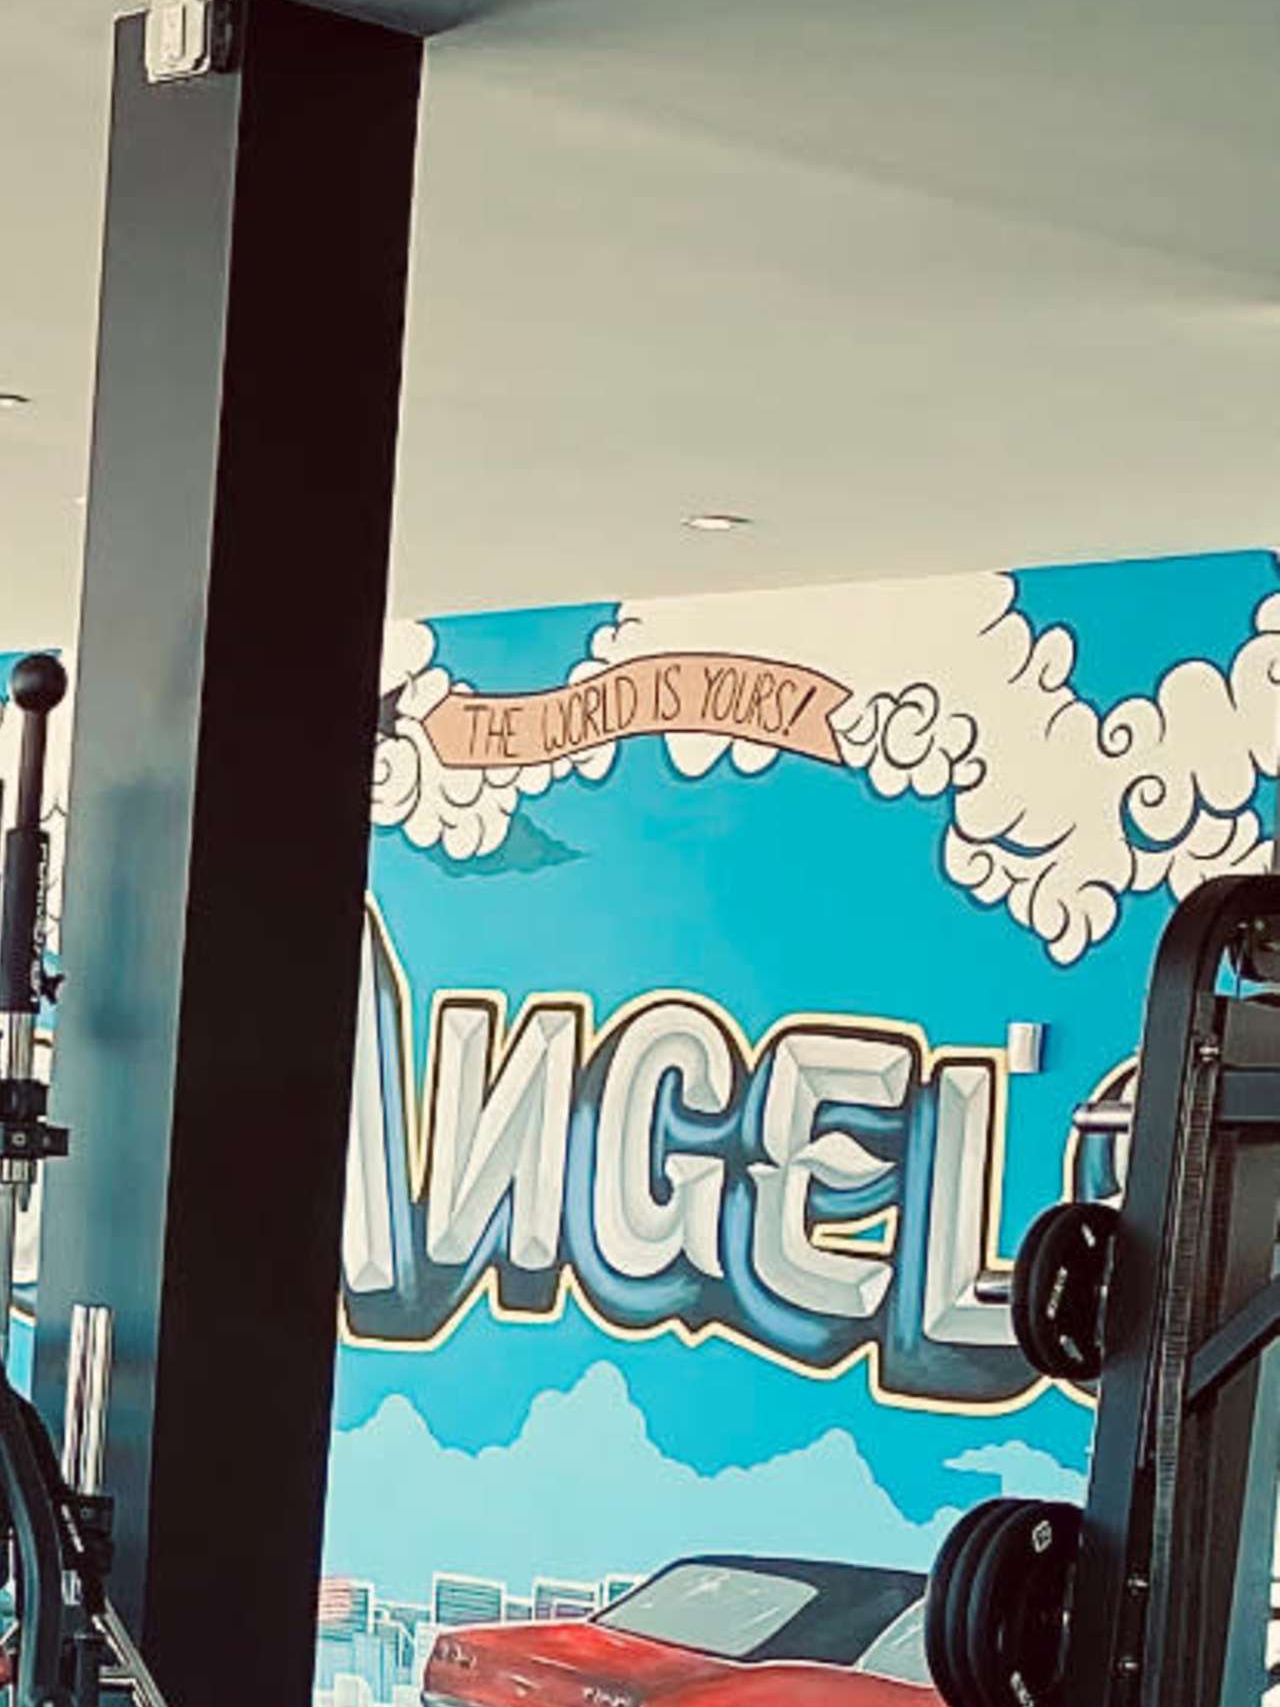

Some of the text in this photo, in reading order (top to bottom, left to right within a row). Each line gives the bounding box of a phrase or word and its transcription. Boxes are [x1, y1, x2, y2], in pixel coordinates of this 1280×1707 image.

[463, 663, 818, 759] THE WORLD IS YOURS!
